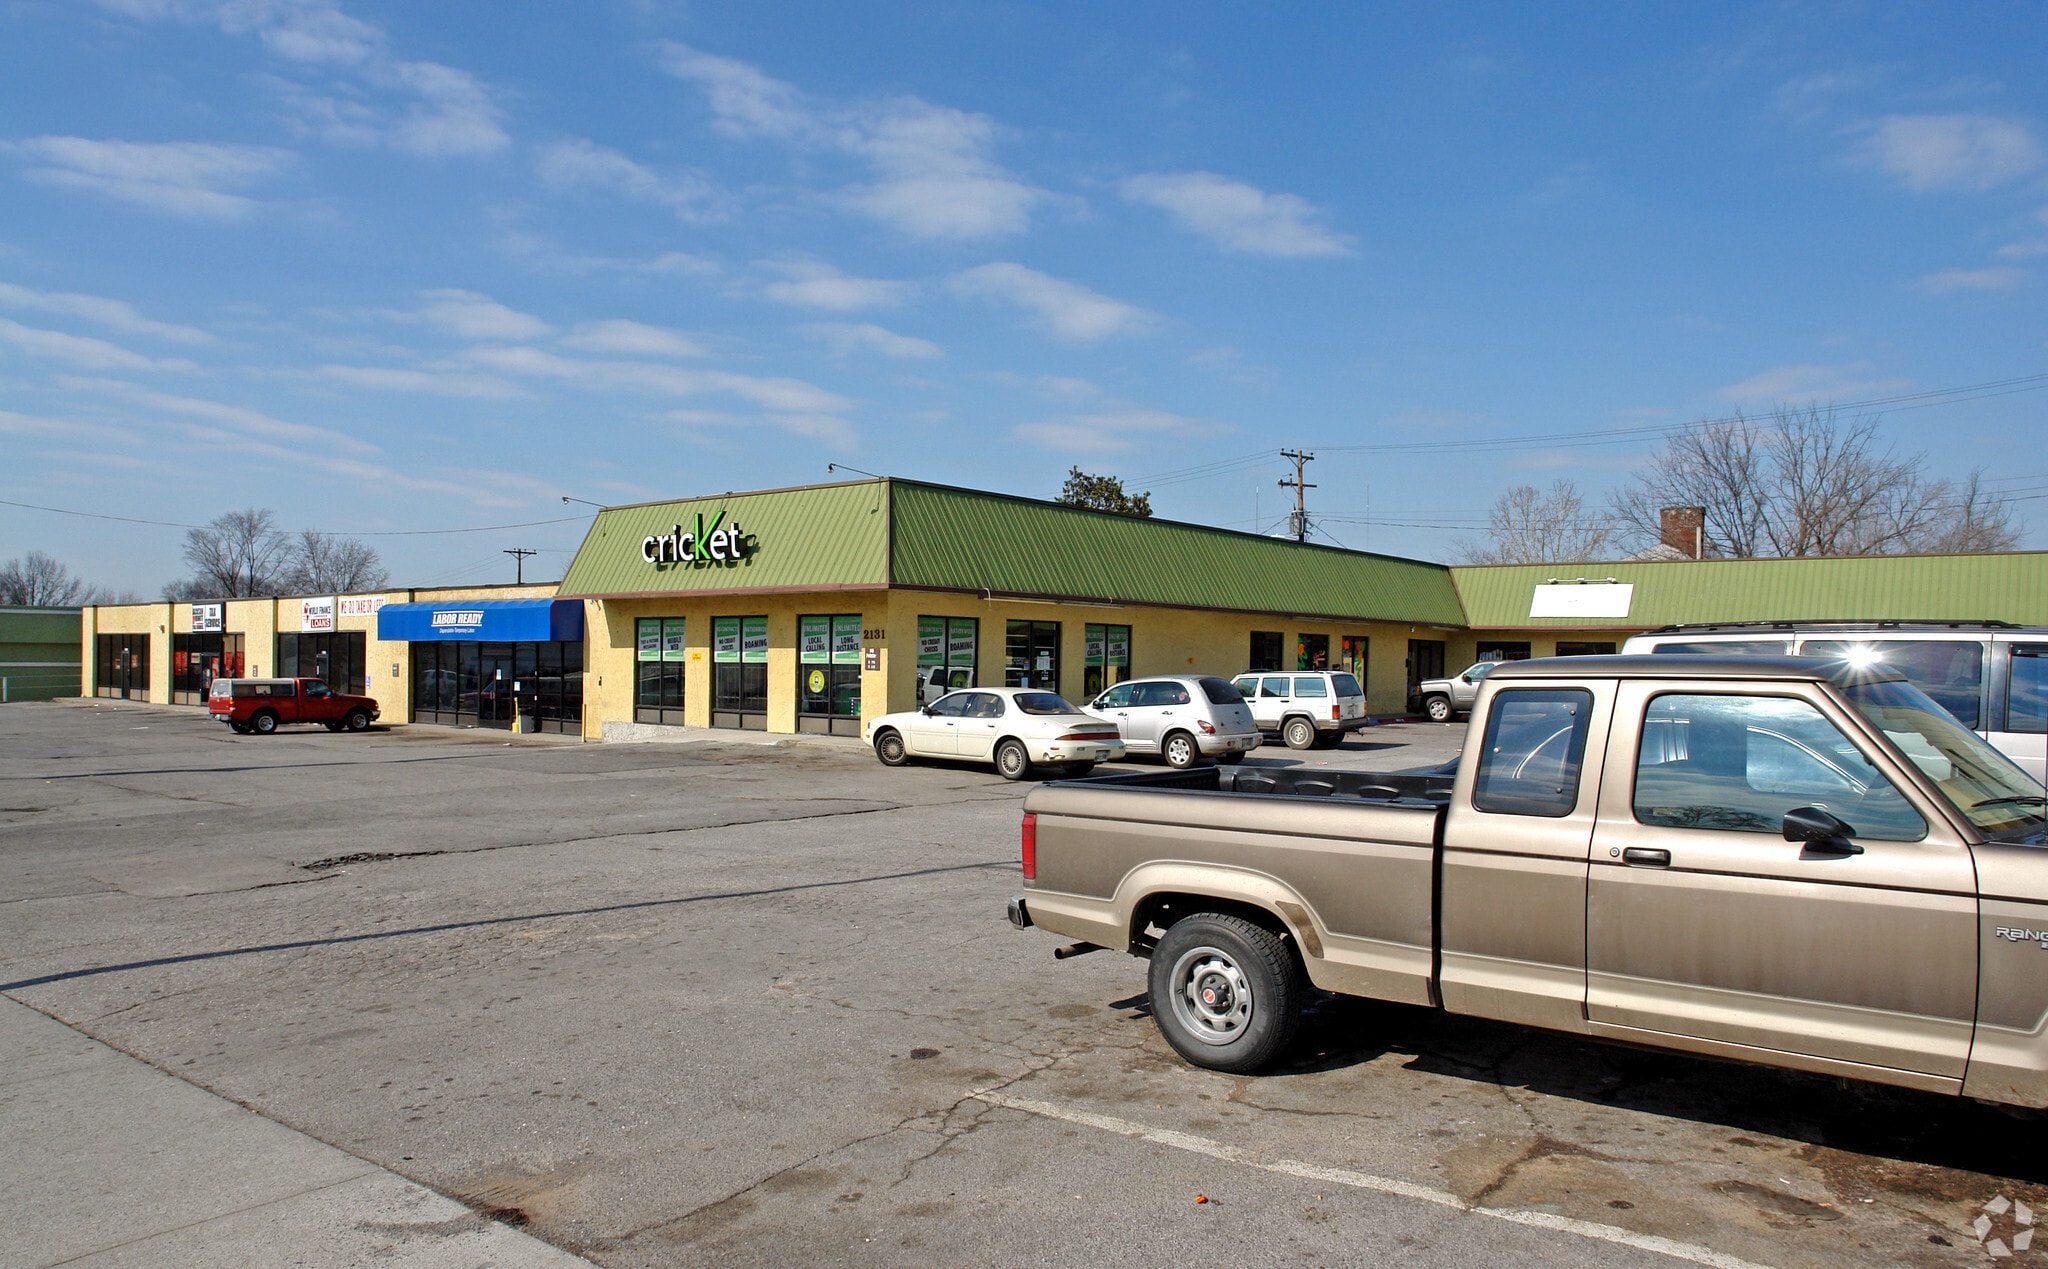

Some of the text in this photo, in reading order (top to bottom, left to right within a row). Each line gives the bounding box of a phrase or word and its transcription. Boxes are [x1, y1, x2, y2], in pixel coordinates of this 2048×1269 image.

[312, 618, 330, 628] LOANS
[432, 613, 483, 625] LABOR READY
[863, 629, 886, 639] 2131
[744, 638, 768, 649] ROAMING
[807, 636, 822, 645] LOCAL
[840, 636, 854, 644] LONG
[805, 643, 825, 652] CALLING
[836, 643, 860, 652] DISTANCE
[950, 641, 973, 651] ROAMING
